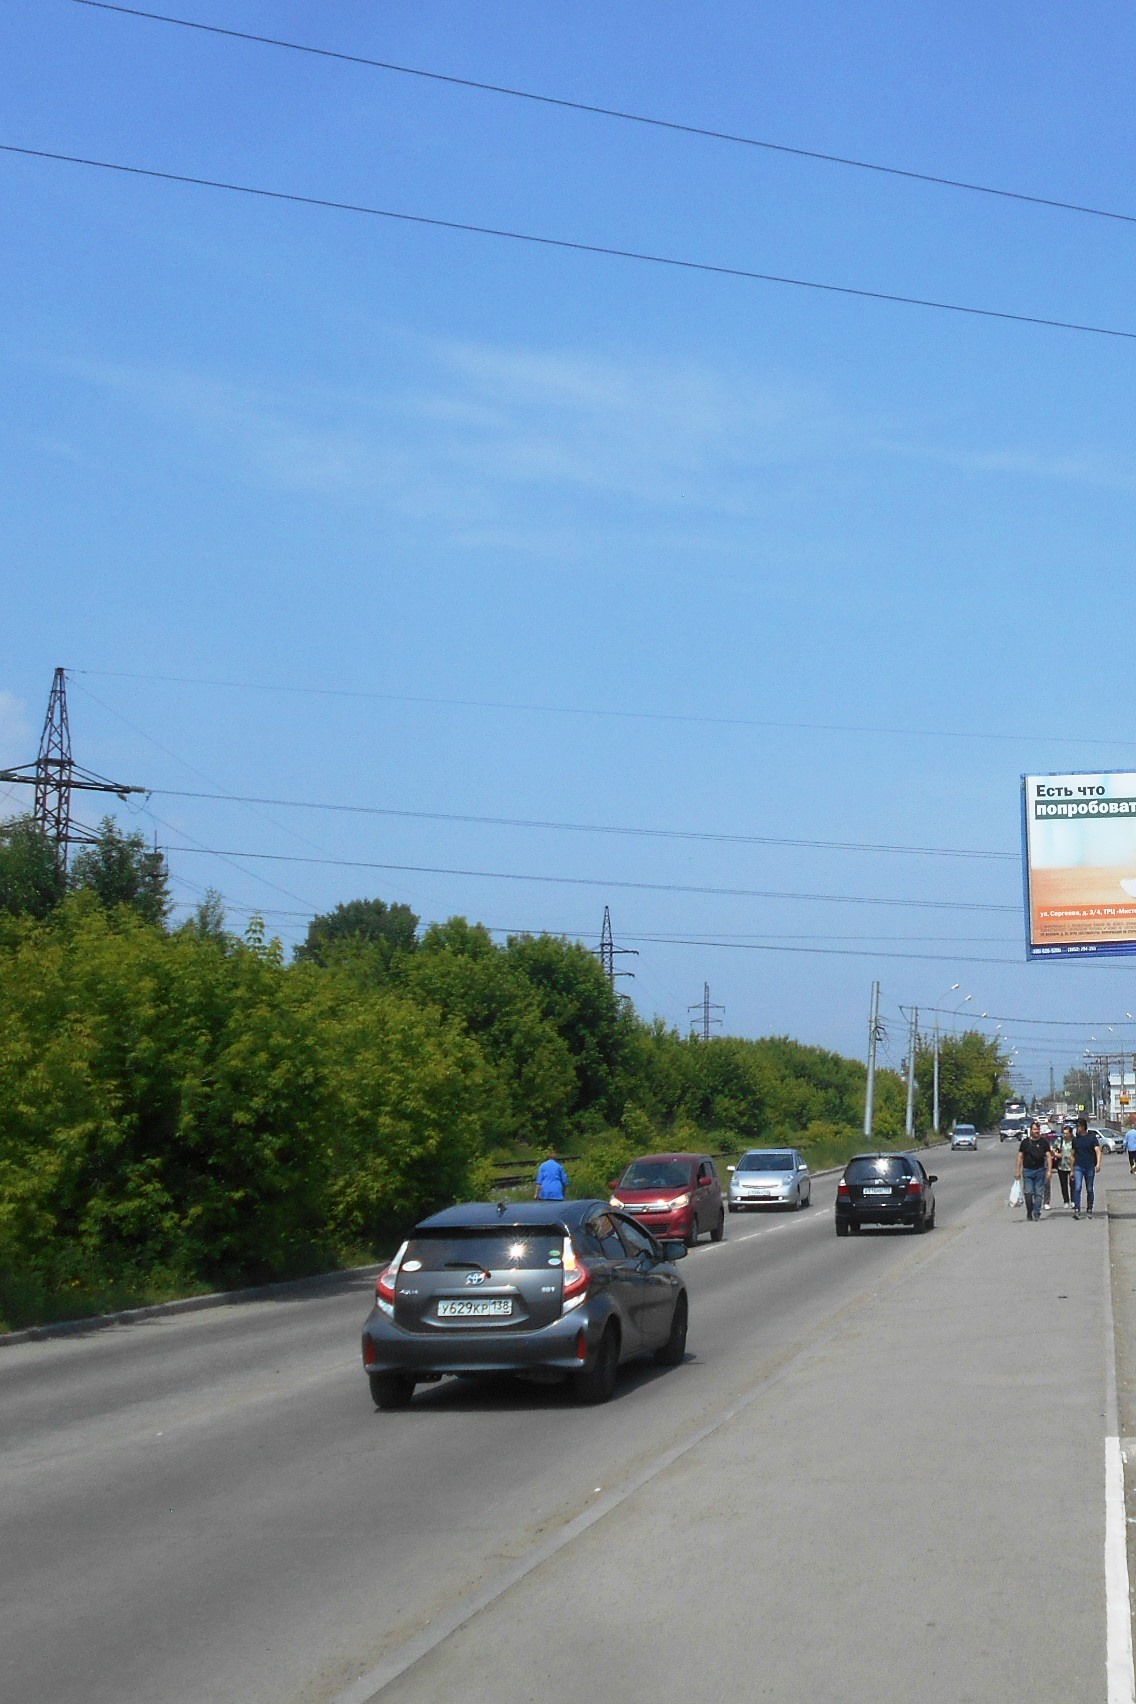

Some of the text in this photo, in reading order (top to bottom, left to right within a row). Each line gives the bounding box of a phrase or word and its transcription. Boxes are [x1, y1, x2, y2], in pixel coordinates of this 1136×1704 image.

[1036, 784, 1106, 797] Есть что
[1103, 908, 1116, 916] ТРЦ
[442, 1300, 509, 1315] У629КР 138
